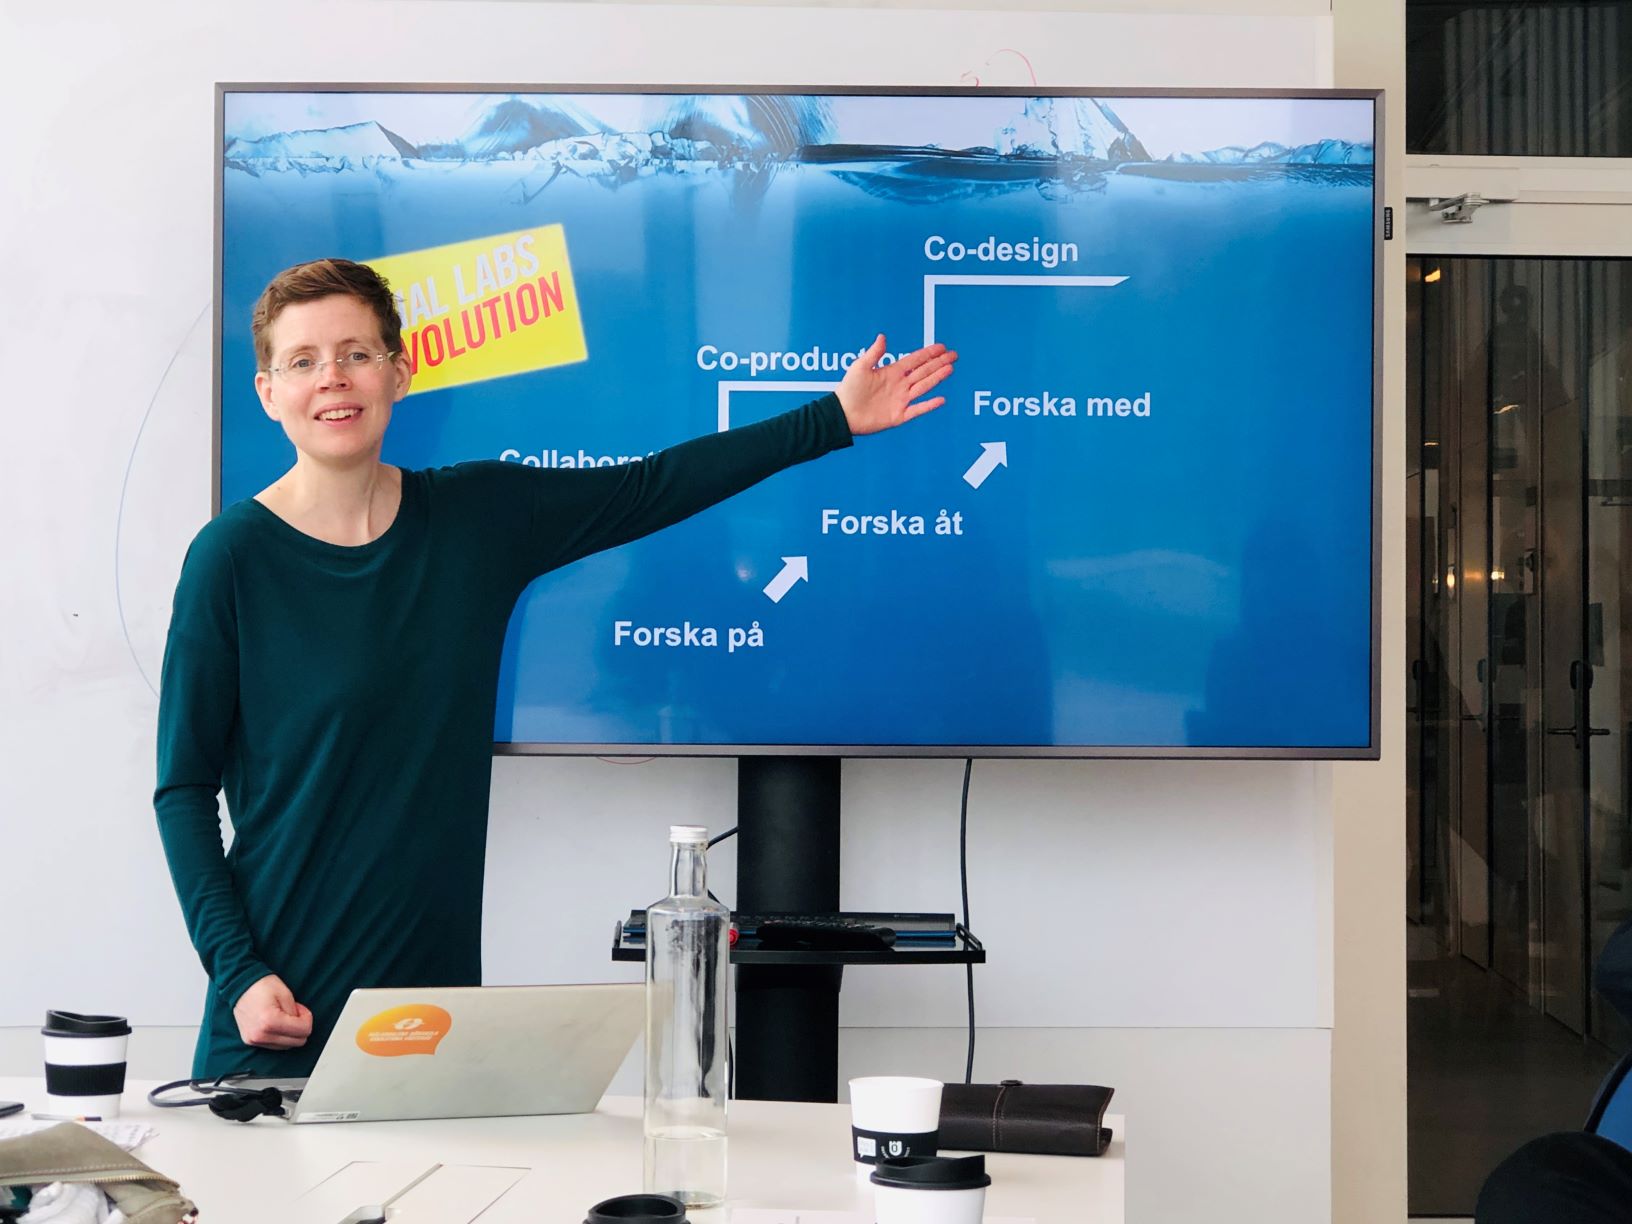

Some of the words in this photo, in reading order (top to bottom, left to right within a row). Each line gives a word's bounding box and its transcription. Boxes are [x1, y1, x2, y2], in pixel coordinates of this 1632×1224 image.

[924, 235, 1078, 268] Co-design
[453, 234, 541, 306] LABS
[696, 345, 911, 376] Co-produco
[974, 390, 1076, 416] Forska
[1087, 392, 1151, 416] med
[500, 449, 662, 469] Collabor
[822, 509, 924, 534] Forska
[935, 509, 963, 534] åt
[614, 621, 718, 646] Forska
[728, 621, 764, 652] på
